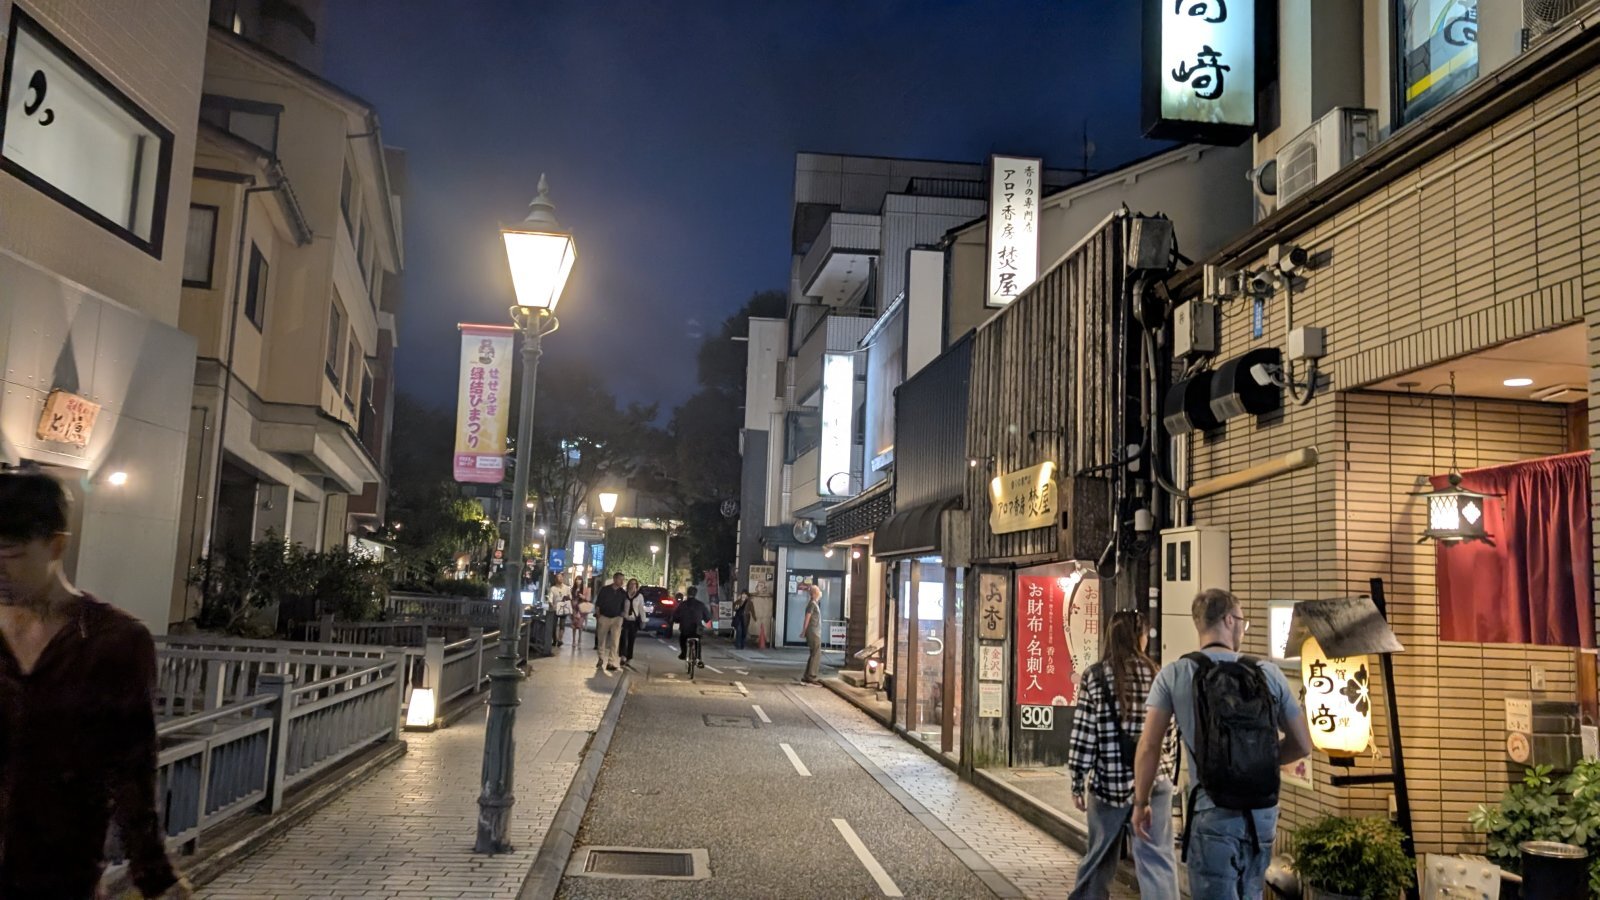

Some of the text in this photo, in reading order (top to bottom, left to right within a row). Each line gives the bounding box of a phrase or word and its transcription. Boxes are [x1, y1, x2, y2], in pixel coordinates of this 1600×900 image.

[1001, 169, 1016, 240] アロマ香房
[468, 366, 485, 449] 縁結びまつり
[486, 368, 499, 416] せせらぎ
[1026, 582, 1044, 691] お財布・名刺入
[1046, 646, 1056, 675] 香り袋
[990, 648, 1001, 677] 金沢の
[1022, 706, 1052, 726] 300
